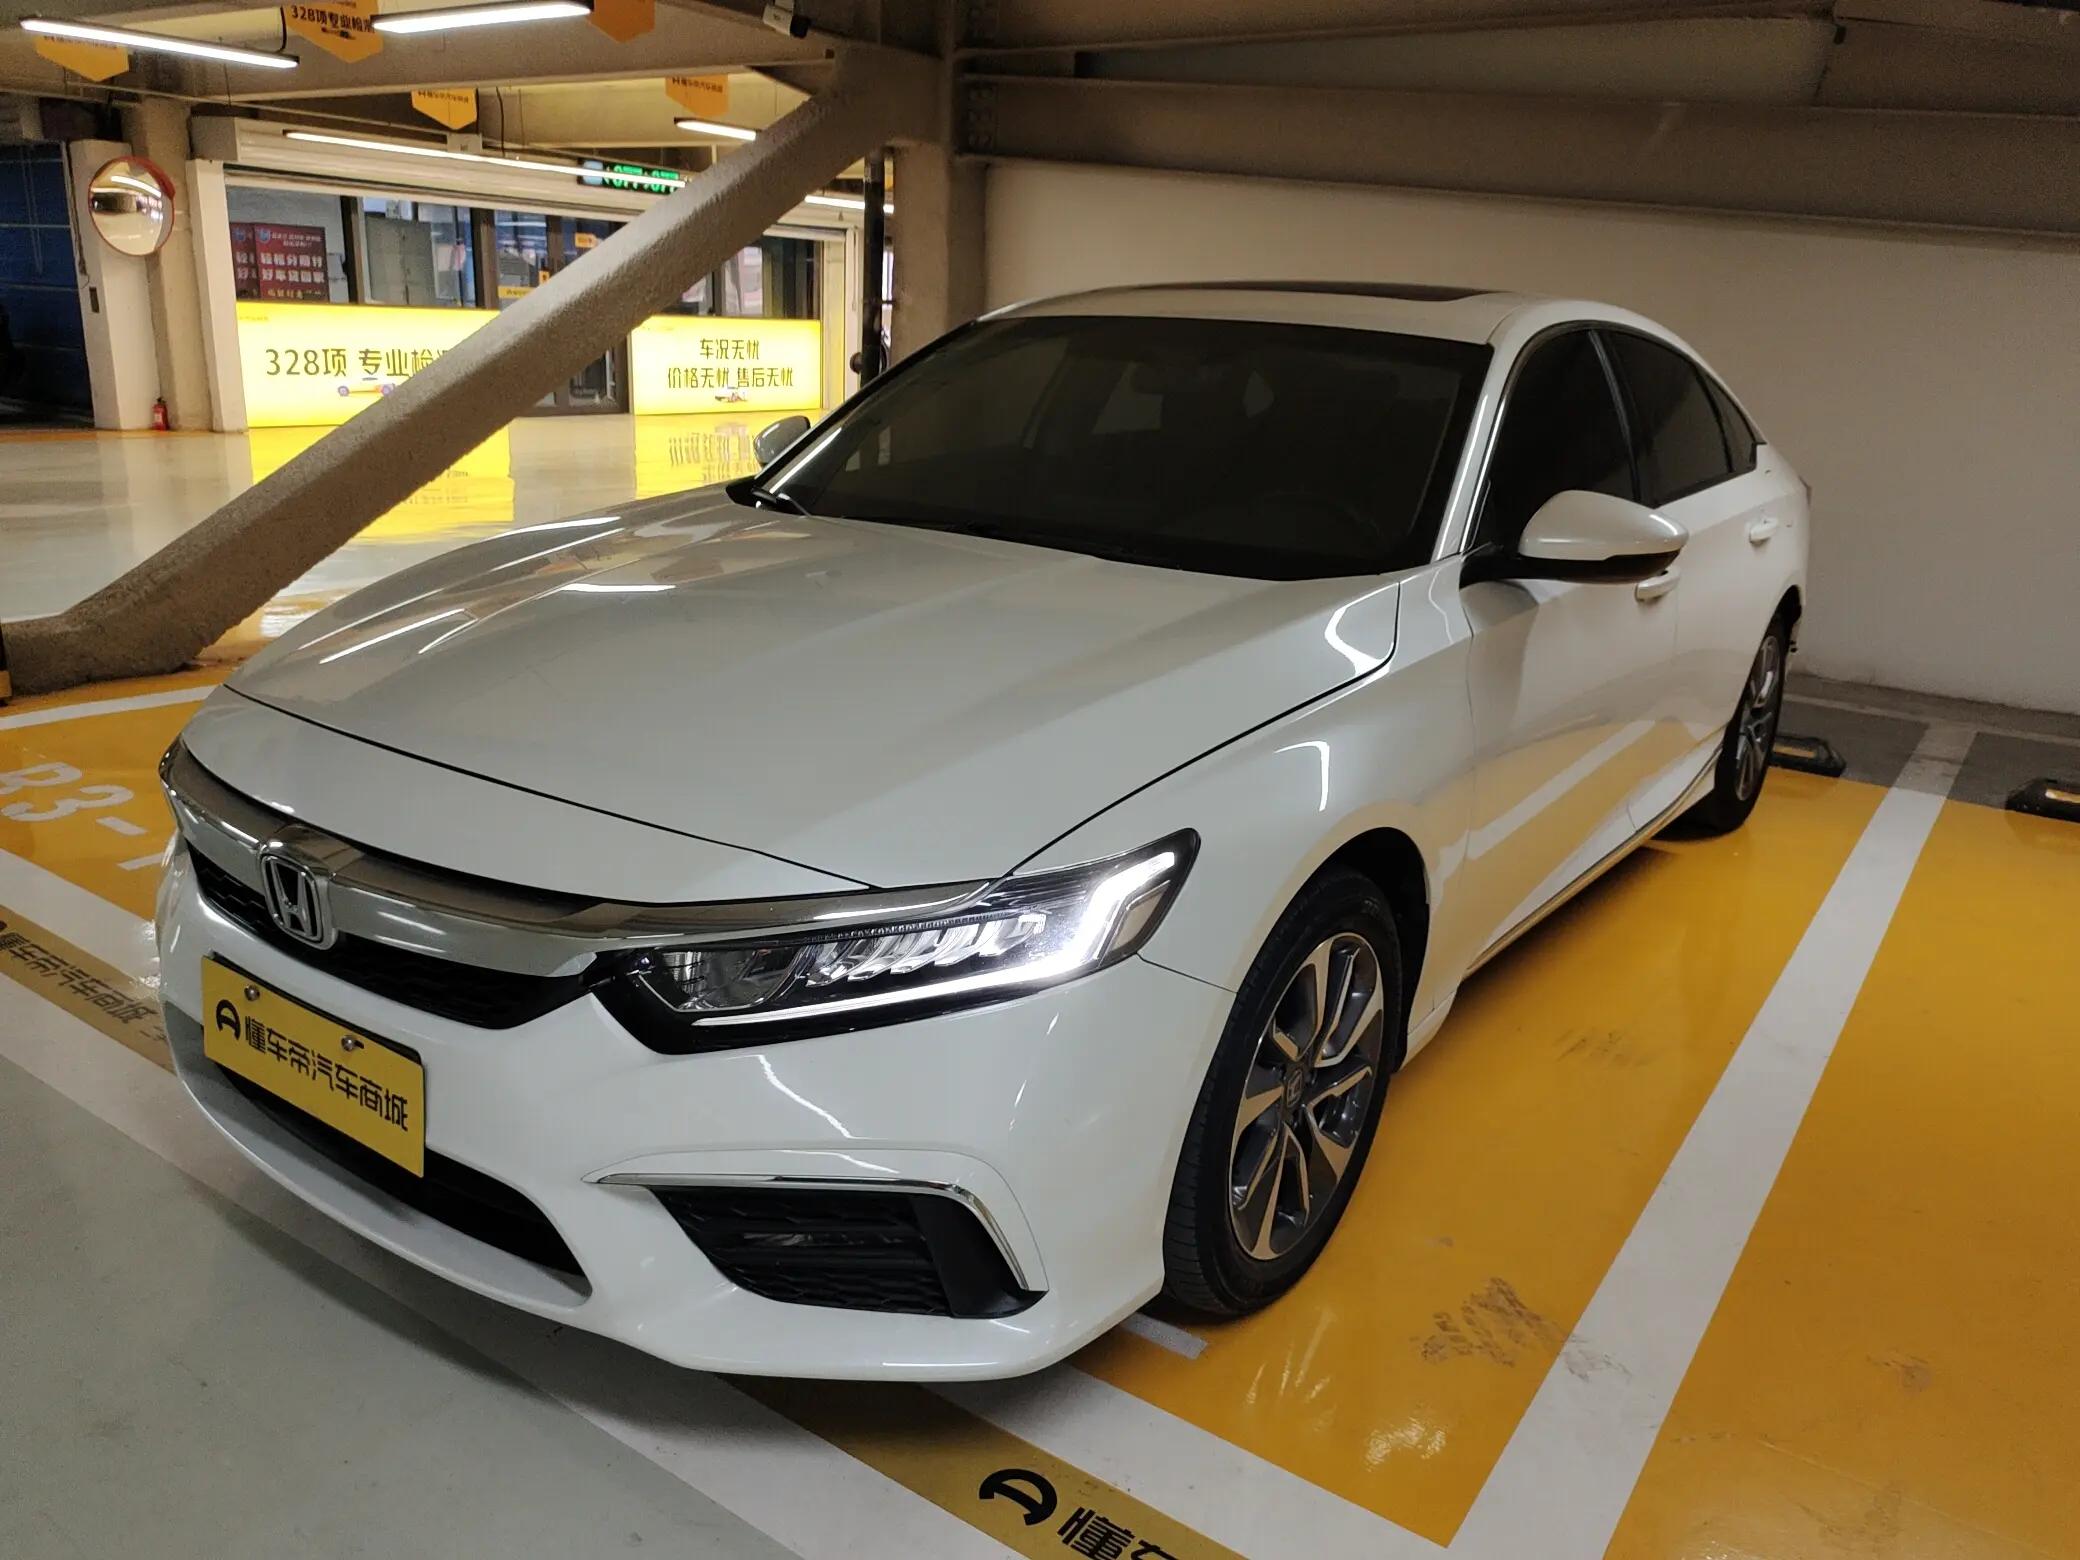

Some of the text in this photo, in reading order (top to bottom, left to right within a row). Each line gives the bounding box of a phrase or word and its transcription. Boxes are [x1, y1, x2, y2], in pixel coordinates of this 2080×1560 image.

[265, 347, 450, 378] 328项 专业检
[699, 338, 760, 360] 车况无忧
[667, 366, 794, 389] 价格无忧 售后无忧
[244, 1015, 409, 1132] 懂车帝汽车商城
